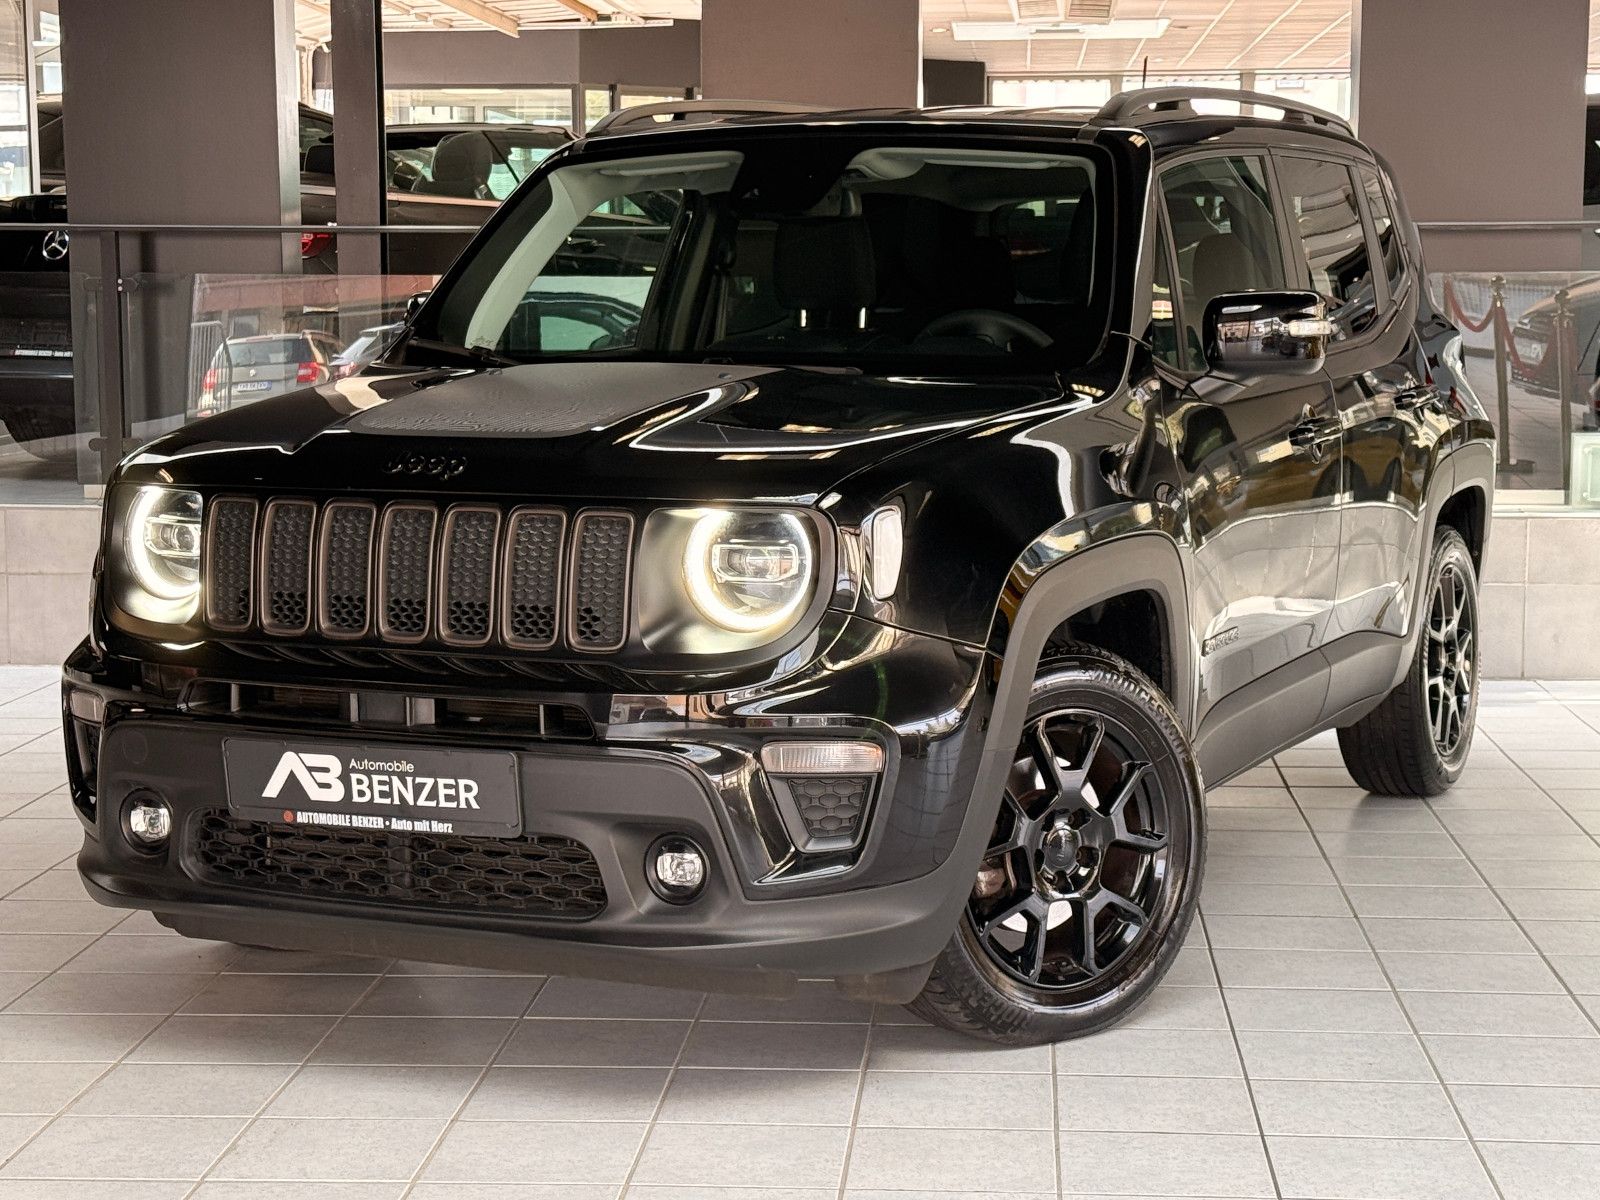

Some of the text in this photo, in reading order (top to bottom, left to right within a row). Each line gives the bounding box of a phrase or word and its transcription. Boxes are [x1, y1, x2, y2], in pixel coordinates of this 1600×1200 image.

[261, 751, 345, 802] AB
[349, 758, 415, 773] Automobile
[350, 773, 480, 809] BENZER
[296, 811, 453, 833] AUTOMOBILE BENZER Auto mit Herz
